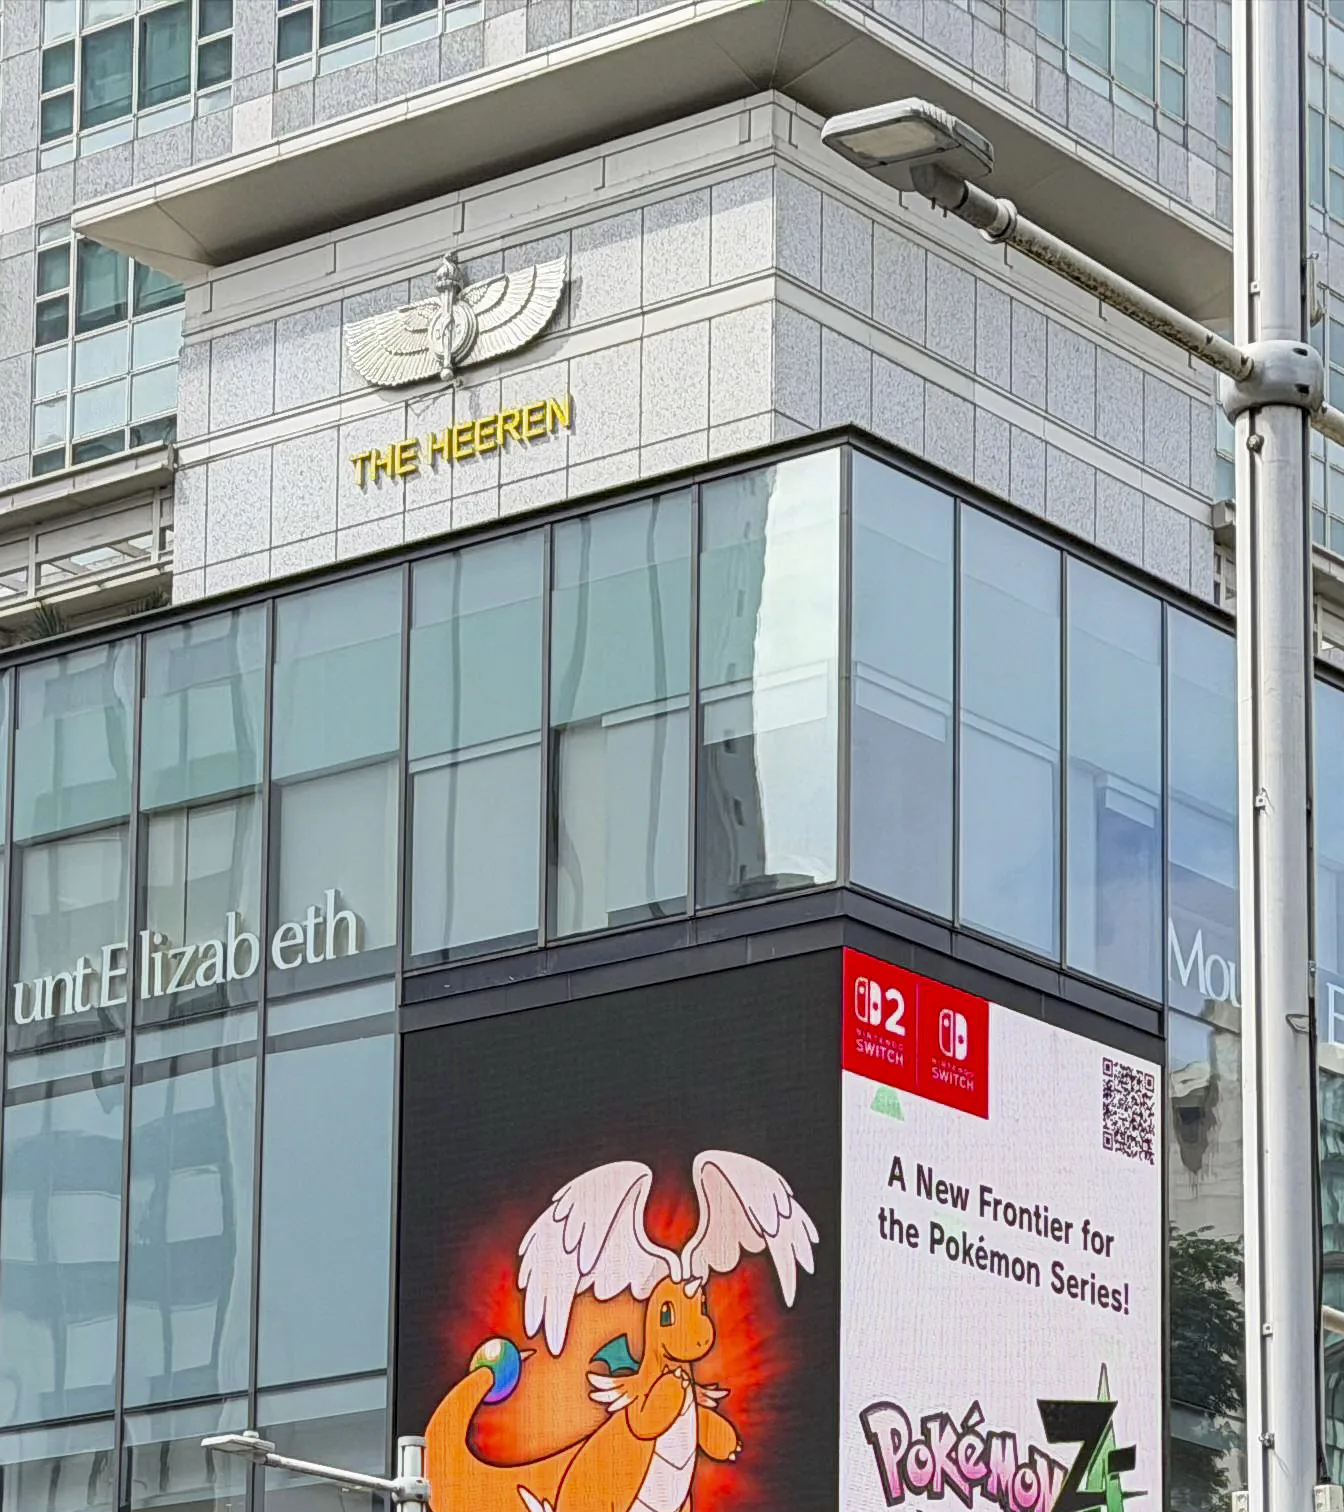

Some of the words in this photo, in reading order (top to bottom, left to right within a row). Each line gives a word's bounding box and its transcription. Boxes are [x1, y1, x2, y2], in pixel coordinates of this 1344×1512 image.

[350, 438, 421, 487] THE
[425, 393, 574, 467] HEEREN
[856, 1038, 904, 1068] SWITCH
[931, 1066, 975, 1092] SWITCH
[887, 1155, 906, 1192] A
[916, 1162, 970, 1212] New
[979, 1184, 1074, 1245] Frontier
[1081, 1219, 1115, 1259] for
[878, 1206, 920, 1249] the
[929, 1219, 1041, 1288] Pokémon
[1050, 1260, 1130, 1315] Series!
